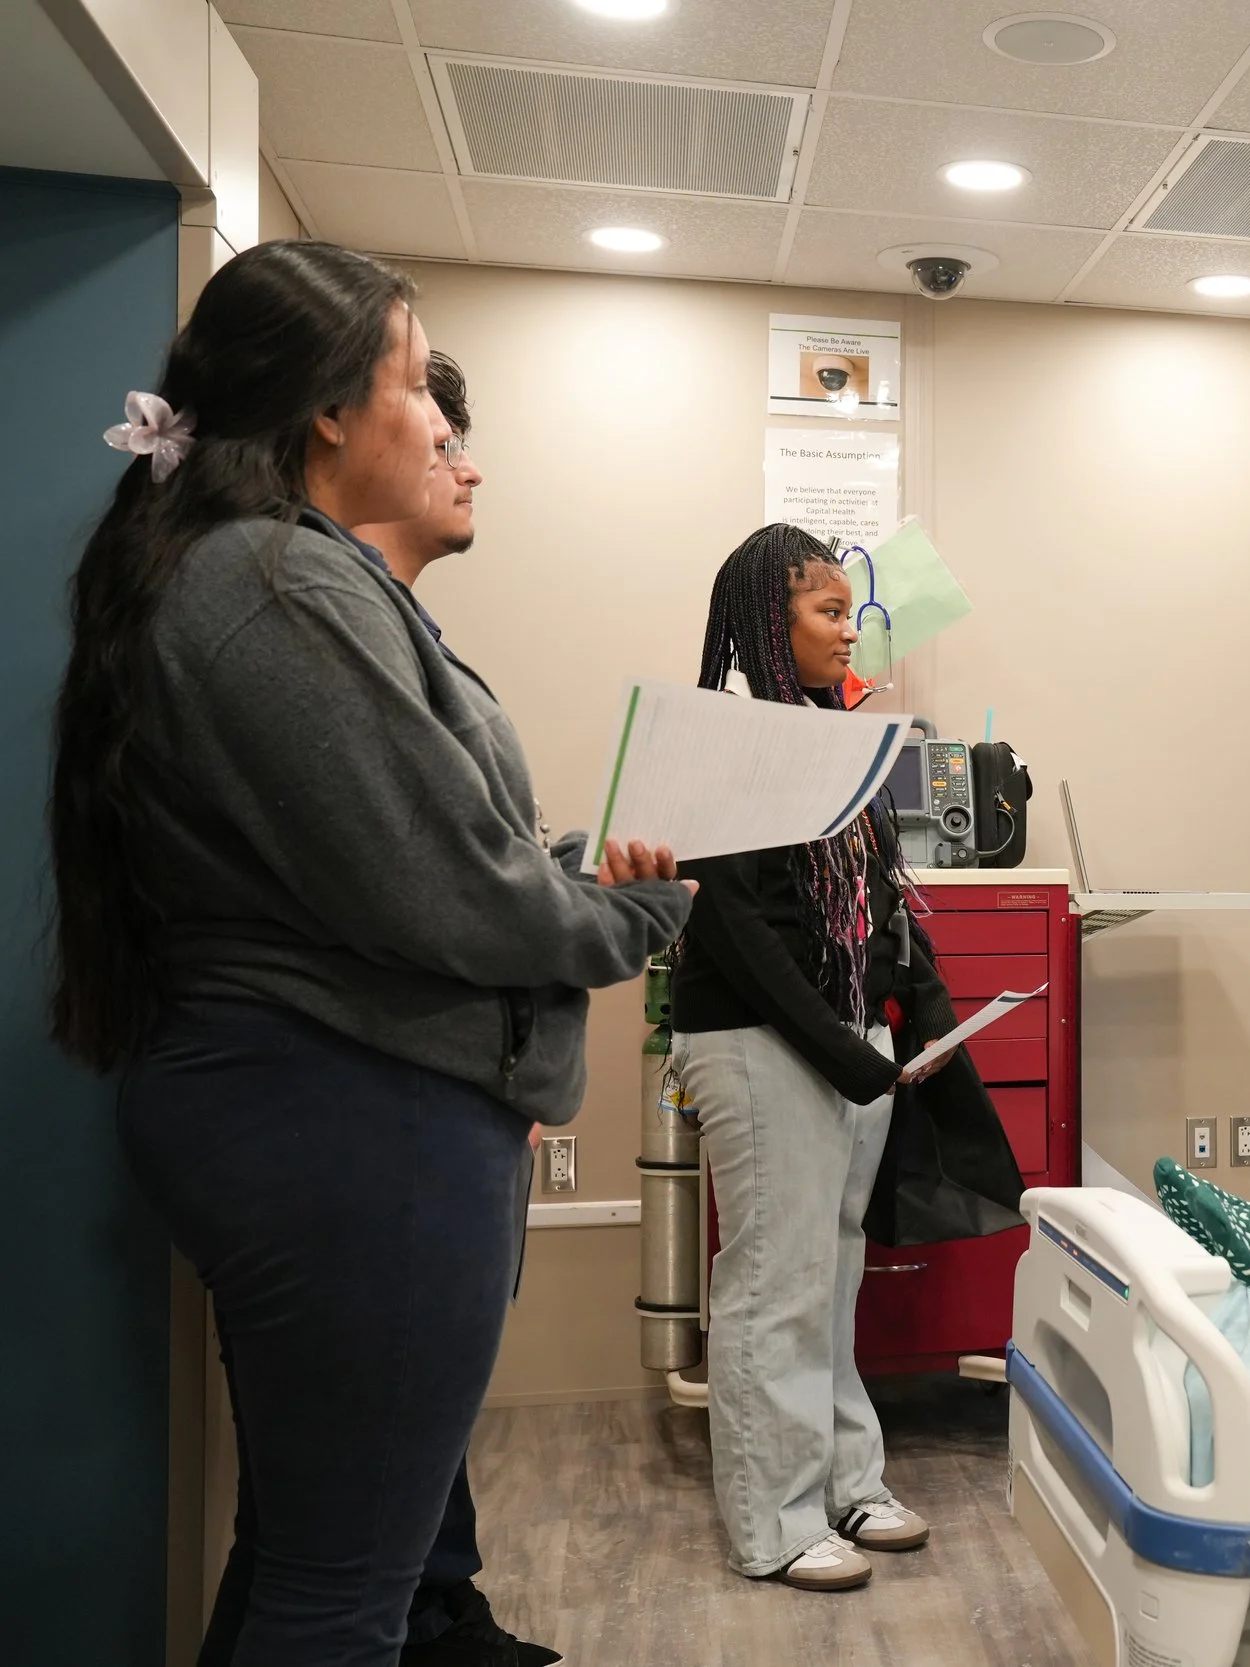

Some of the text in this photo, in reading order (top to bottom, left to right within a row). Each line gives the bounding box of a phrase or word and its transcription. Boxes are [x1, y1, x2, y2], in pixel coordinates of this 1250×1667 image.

[806, 336, 829, 344] Please
[830, 337, 840, 345] Be
[812, 344, 842, 353] Cameras
[779, 448, 798, 457] The
[800, 448, 824, 458] Basic
[799, 486, 826, 494] believe
[826, 487, 842, 495] that
[843, 488, 877, 497] everyone
[783, 497, 829, 506] participating
[805, 507, 856, 516] Capital Health
[789, 517, 828, 526] intelligent,
[828, 518, 859, 528] capable,
[827, 528, 845, 536] their
[845, 528, 862, 538] best,
